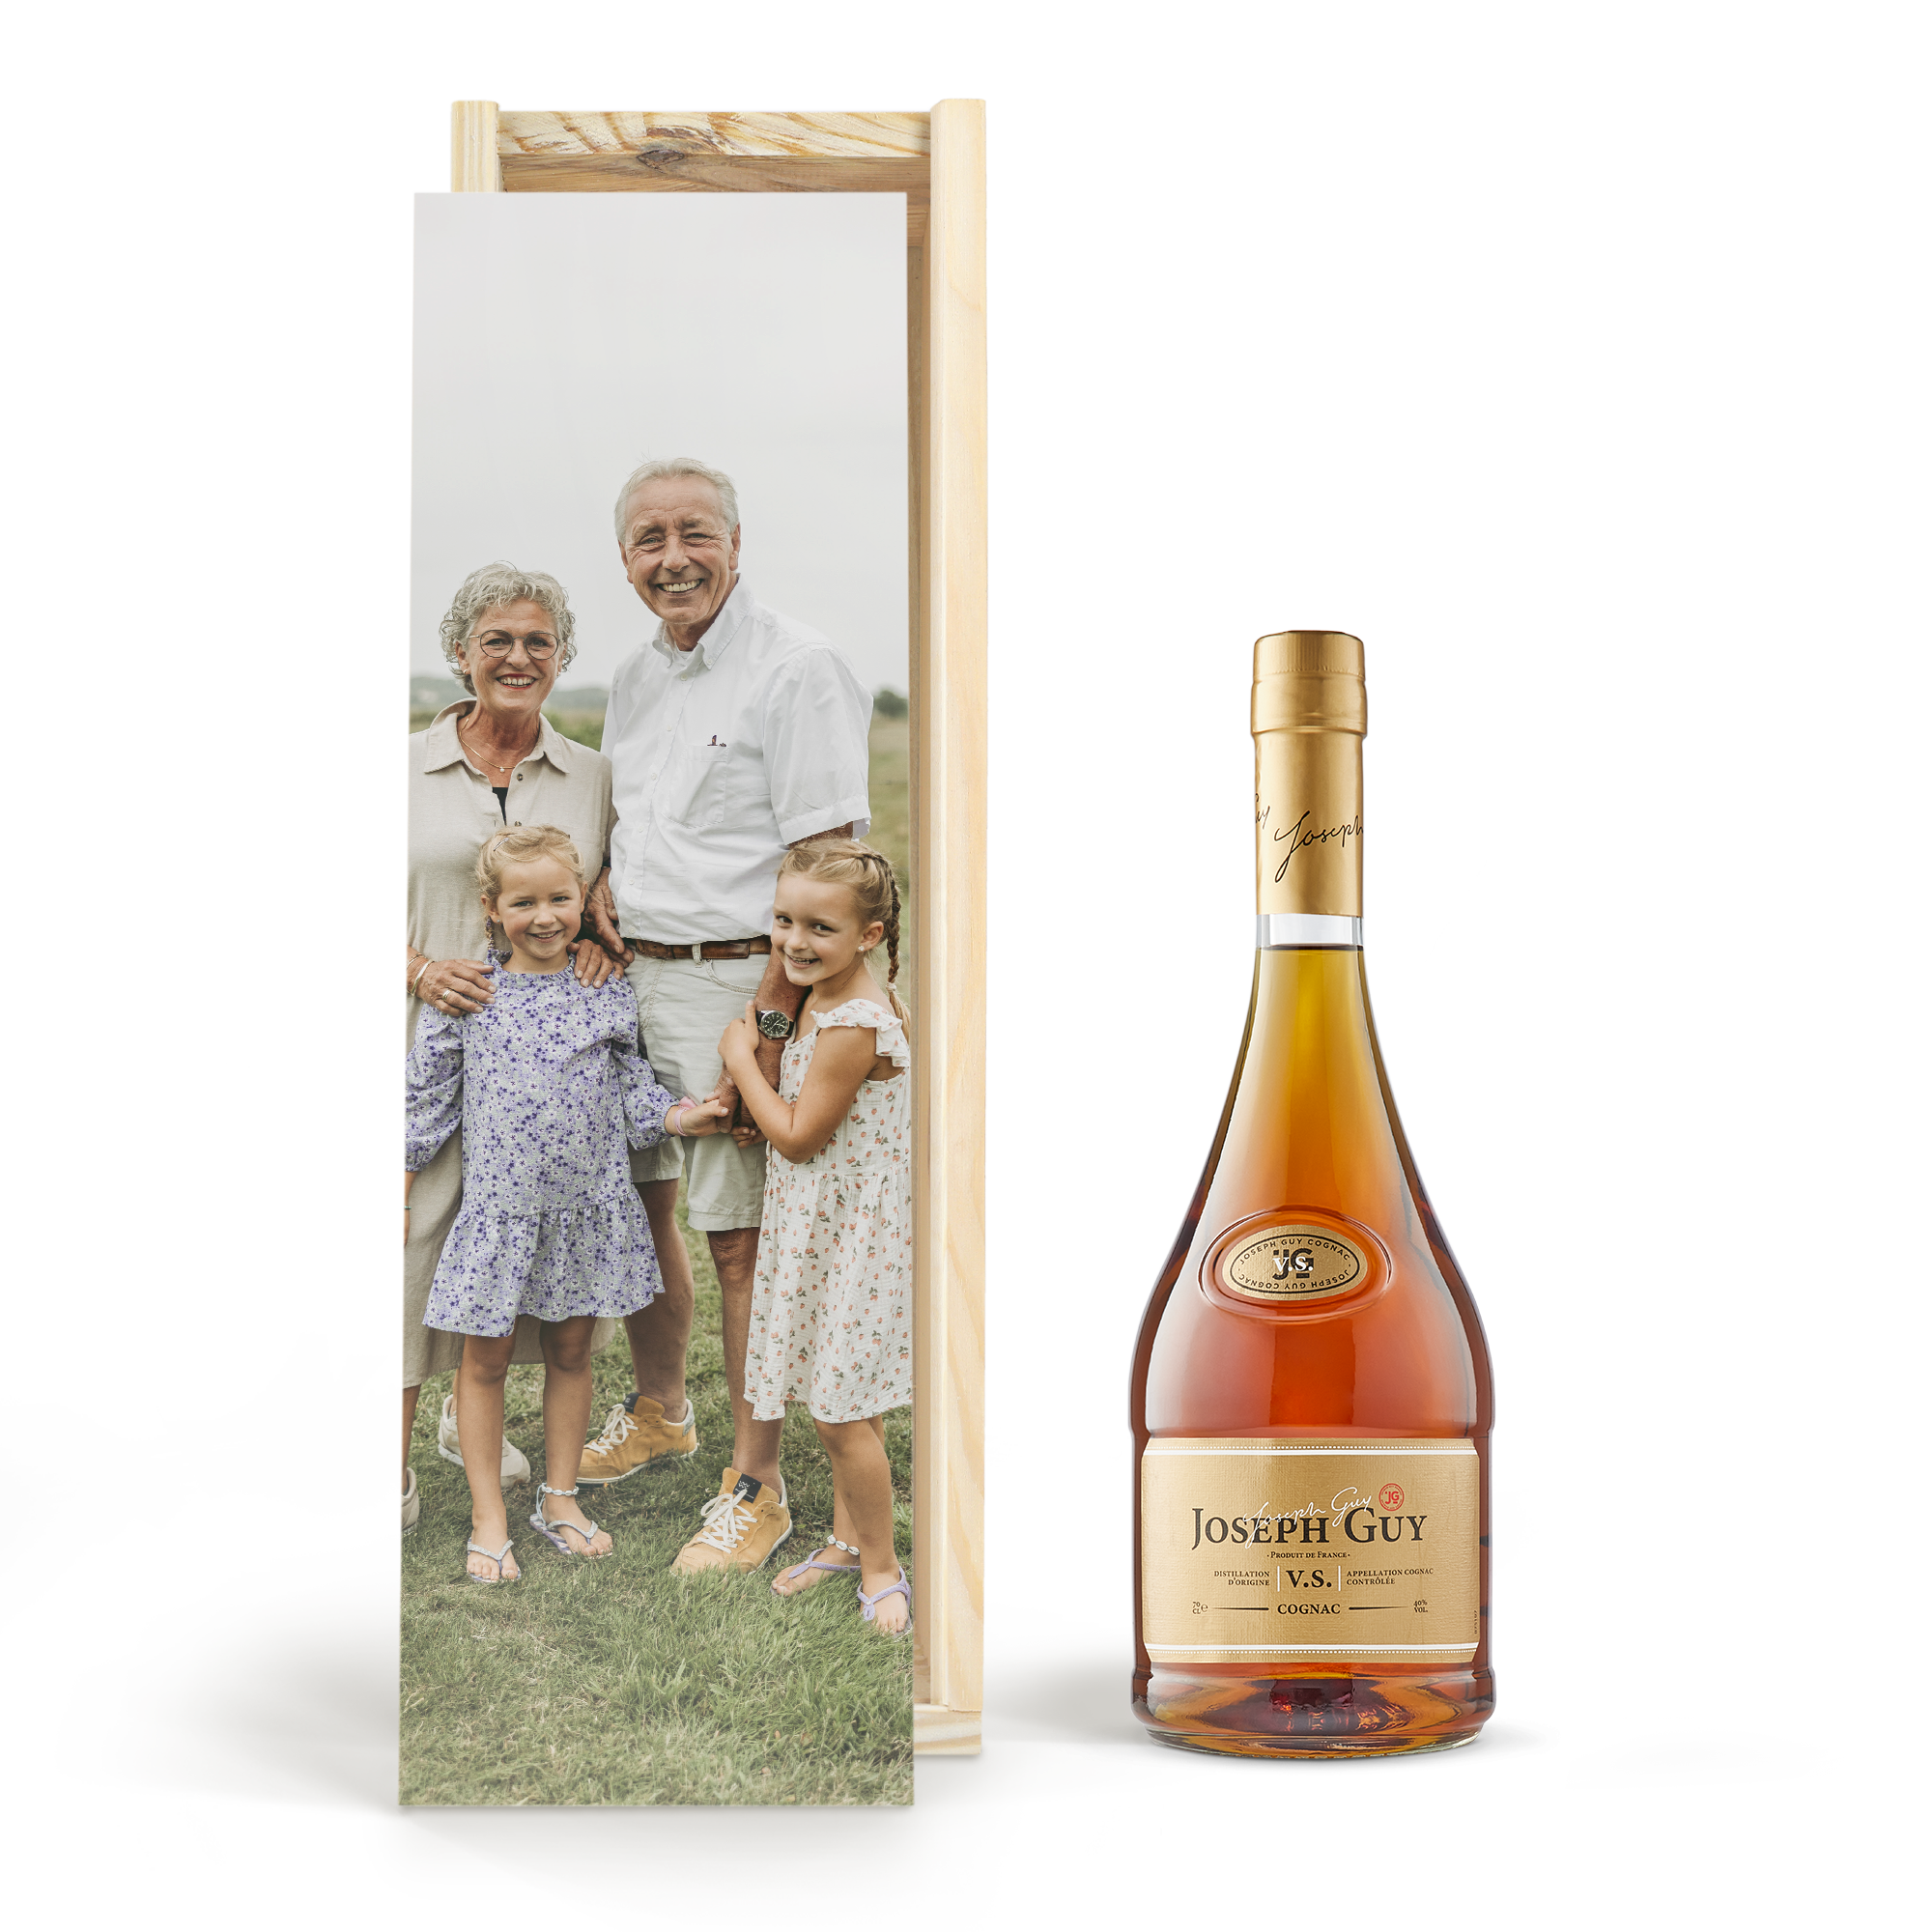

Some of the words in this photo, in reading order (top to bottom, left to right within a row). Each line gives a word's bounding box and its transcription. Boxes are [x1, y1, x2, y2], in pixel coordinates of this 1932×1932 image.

[1274, 810, 1364, 883] Joseph
[1238, 1241, 1276, 1264] JOSEPH
[1281, 1238, 1303, 1247] GUY
[1307, 1238, 1350, 1261] COGNAC
[1238, 1274, 1279, 1290] COGNAC
[1311, 1269, 1350, 1289] JOSEPH
[1242, 1501, 1326, 1549] Joseph
[1330, 1487, 1372, 1527] Guy
[1286, 1570, 1332, 1588] V.S.
[1347, 1577, 1396, 1585] CONTRÔLÉE
[1277, 1604, 1341, 1614] COGNAC
[1413, 1599, 1428, 1607] 40%
